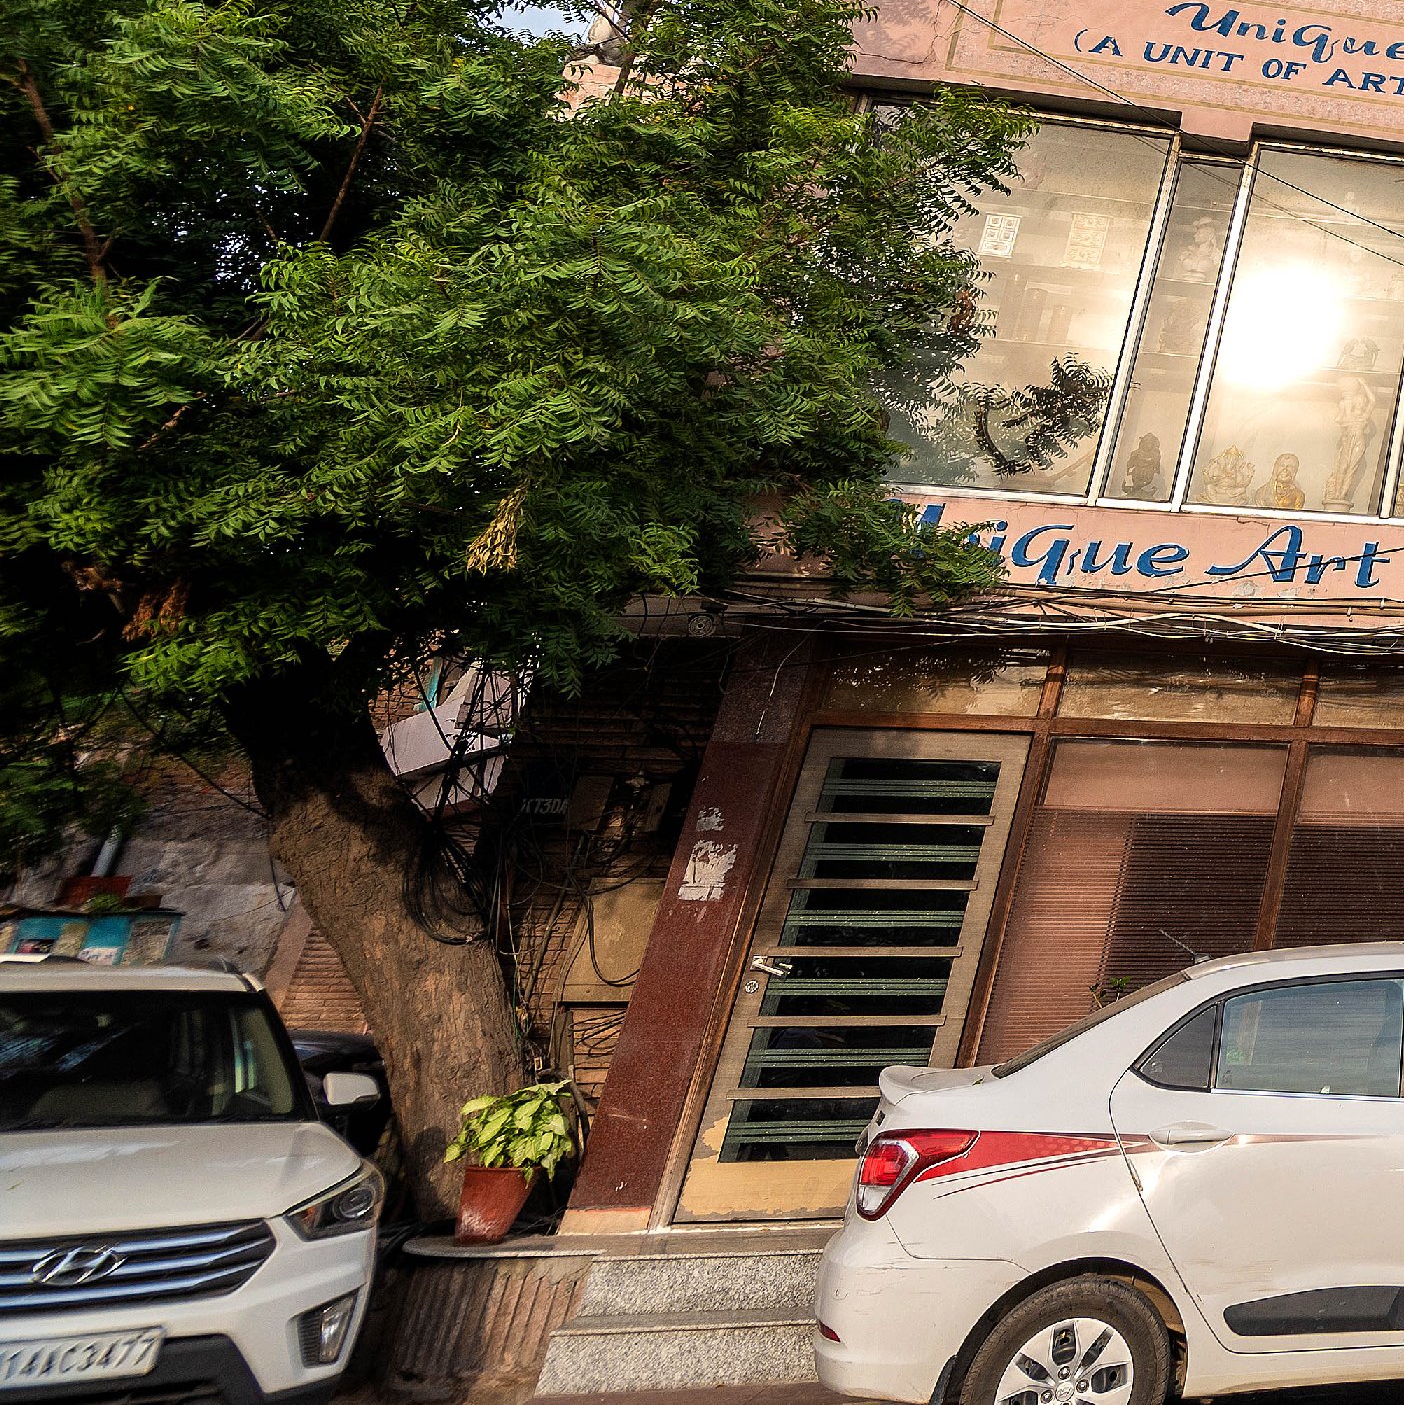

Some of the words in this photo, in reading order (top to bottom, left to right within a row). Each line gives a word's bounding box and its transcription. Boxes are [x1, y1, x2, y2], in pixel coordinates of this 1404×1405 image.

[1143, 41, 1245, 72] UNIT
[1260, 58, 1306, 80] OF
[1206, 525, 1392, 590] Art
